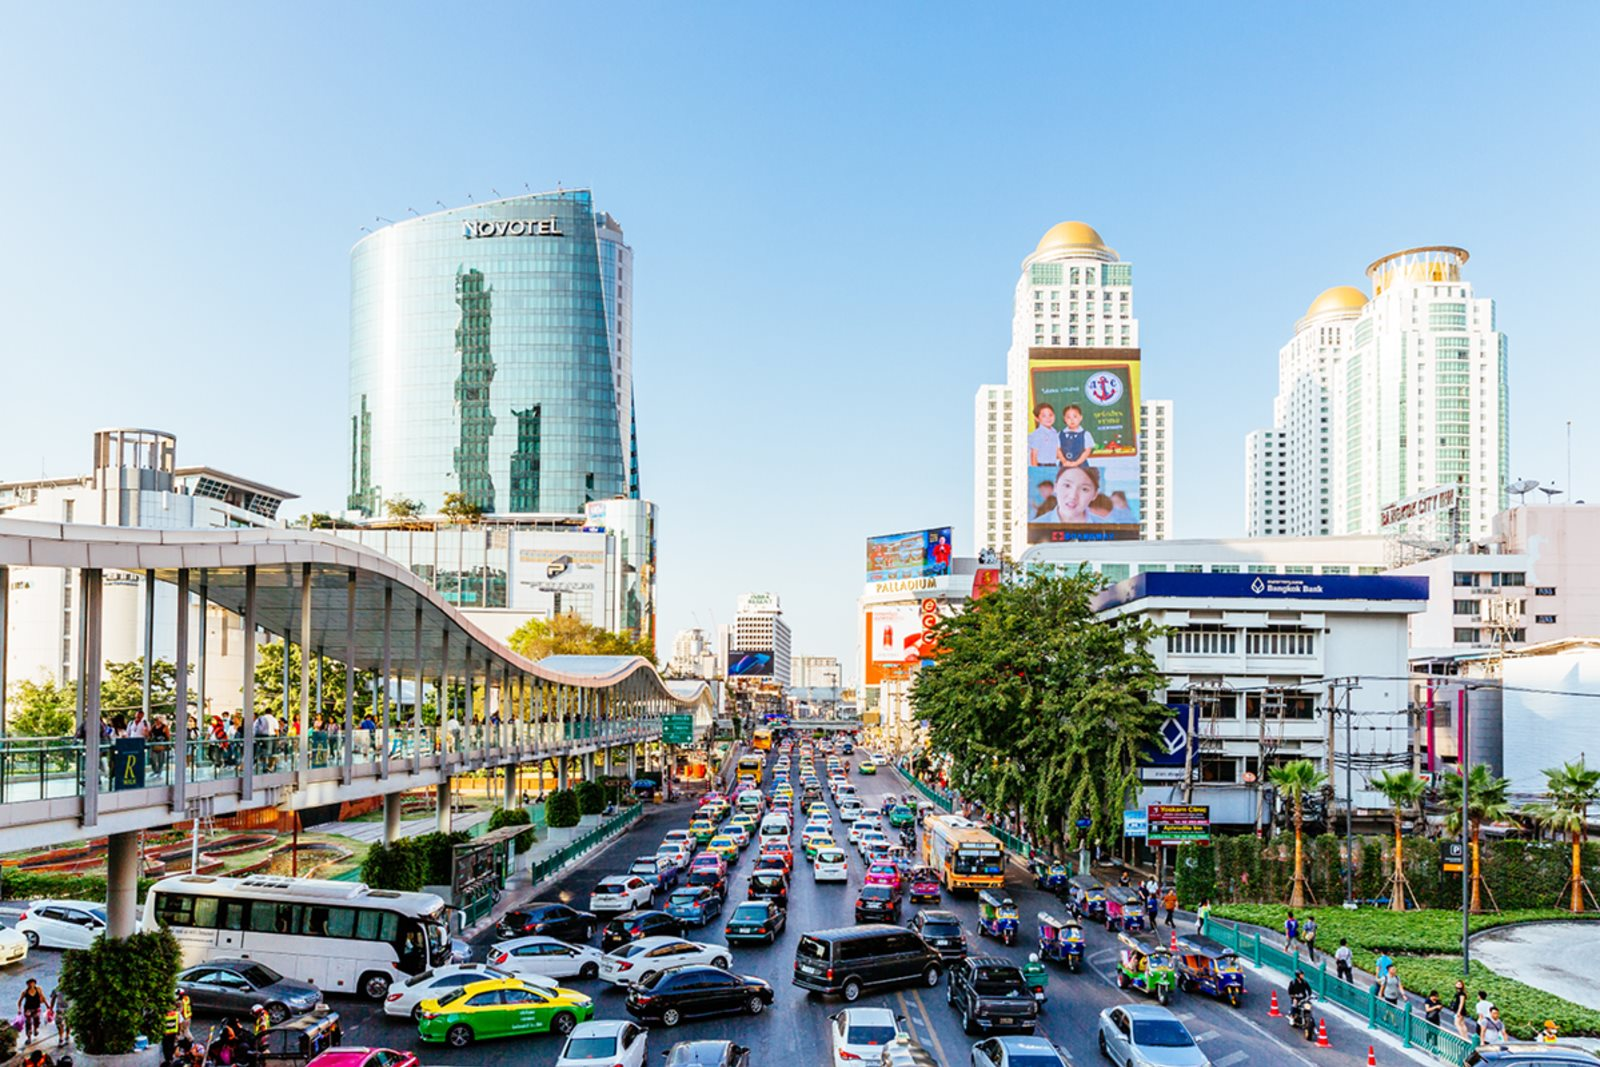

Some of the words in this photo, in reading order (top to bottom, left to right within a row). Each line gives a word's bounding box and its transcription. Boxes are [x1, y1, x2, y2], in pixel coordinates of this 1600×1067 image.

[463, 216, 563, 239] NOVOTEL
[1418, 495, 1438, 514] CITY
[875, 577, 938, 593] PALLADIUM
[1267, 585, 1301, 594] Bangkok
[1302, 585, 1324, 593] Bank
[123, 754, 137, 778] R
